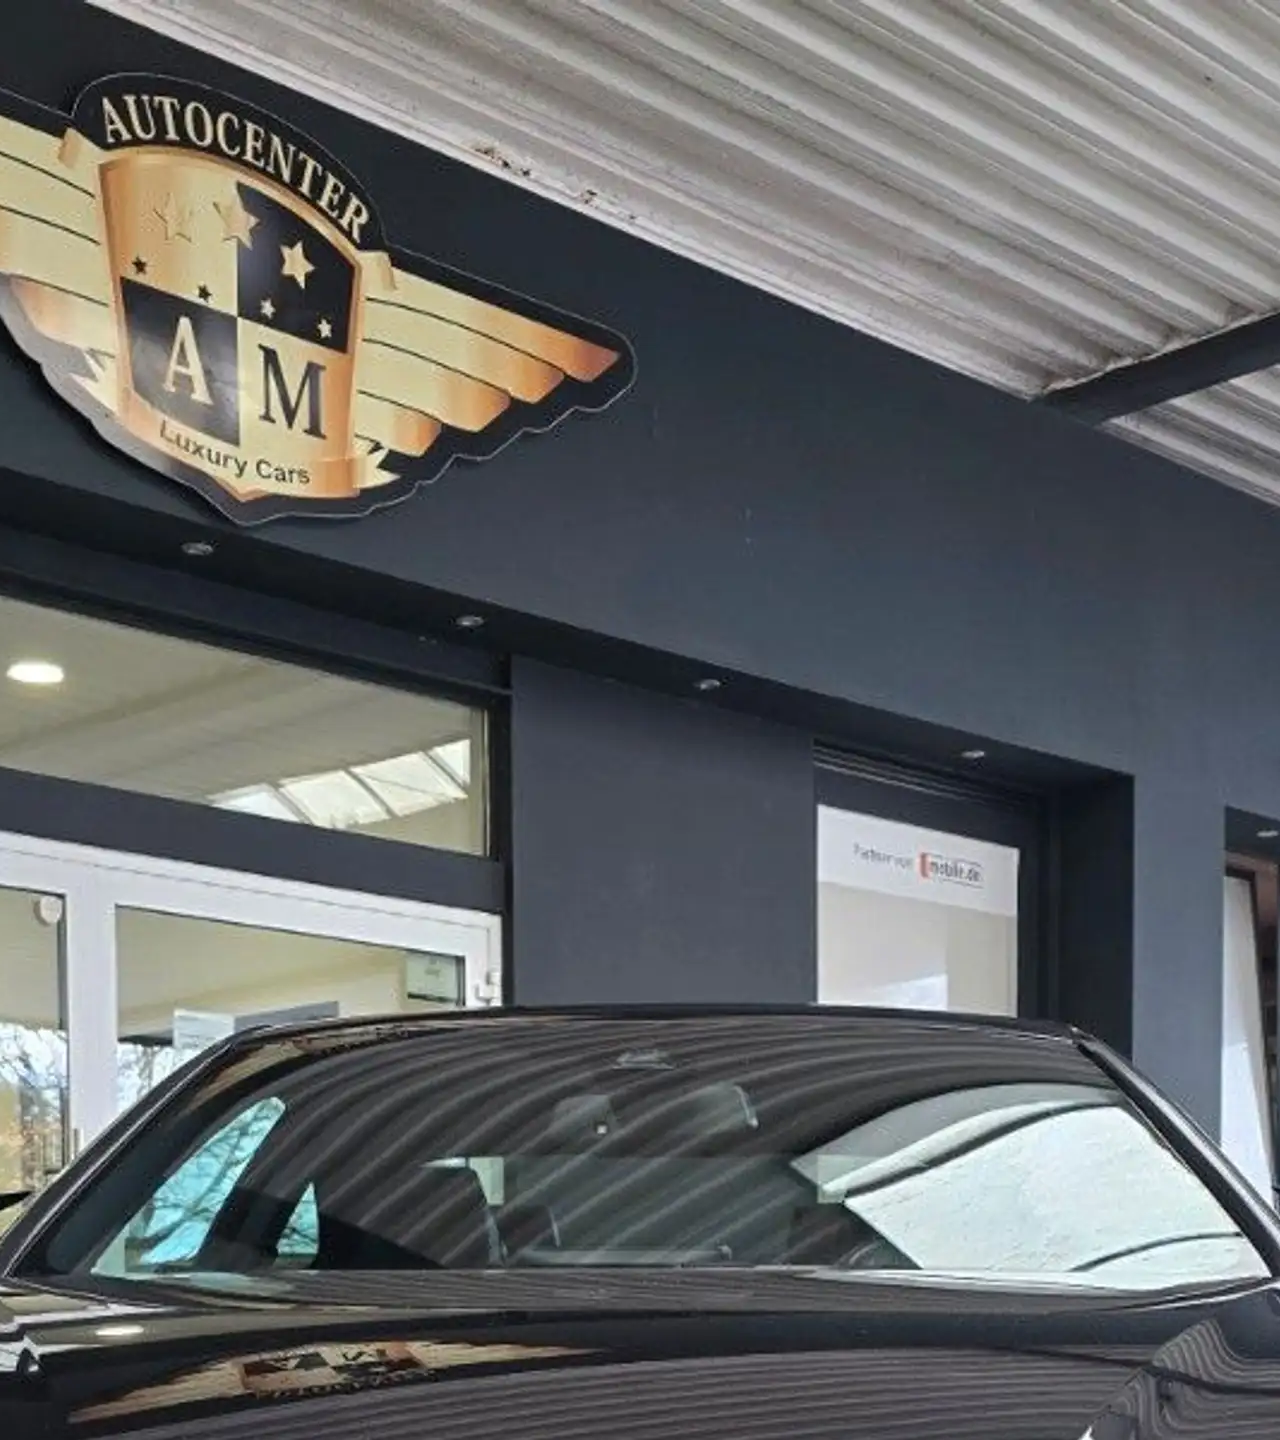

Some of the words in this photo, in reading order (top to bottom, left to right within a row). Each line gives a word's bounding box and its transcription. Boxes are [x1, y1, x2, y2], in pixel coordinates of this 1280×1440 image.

[101, 94, 370, 244] AUTOCENTER
[162, 316, 214, 406] A
[258, 343, 327, 440] M
[160, 420, 248, 479] Luxury
[256, 457, 311, 485] Cars
